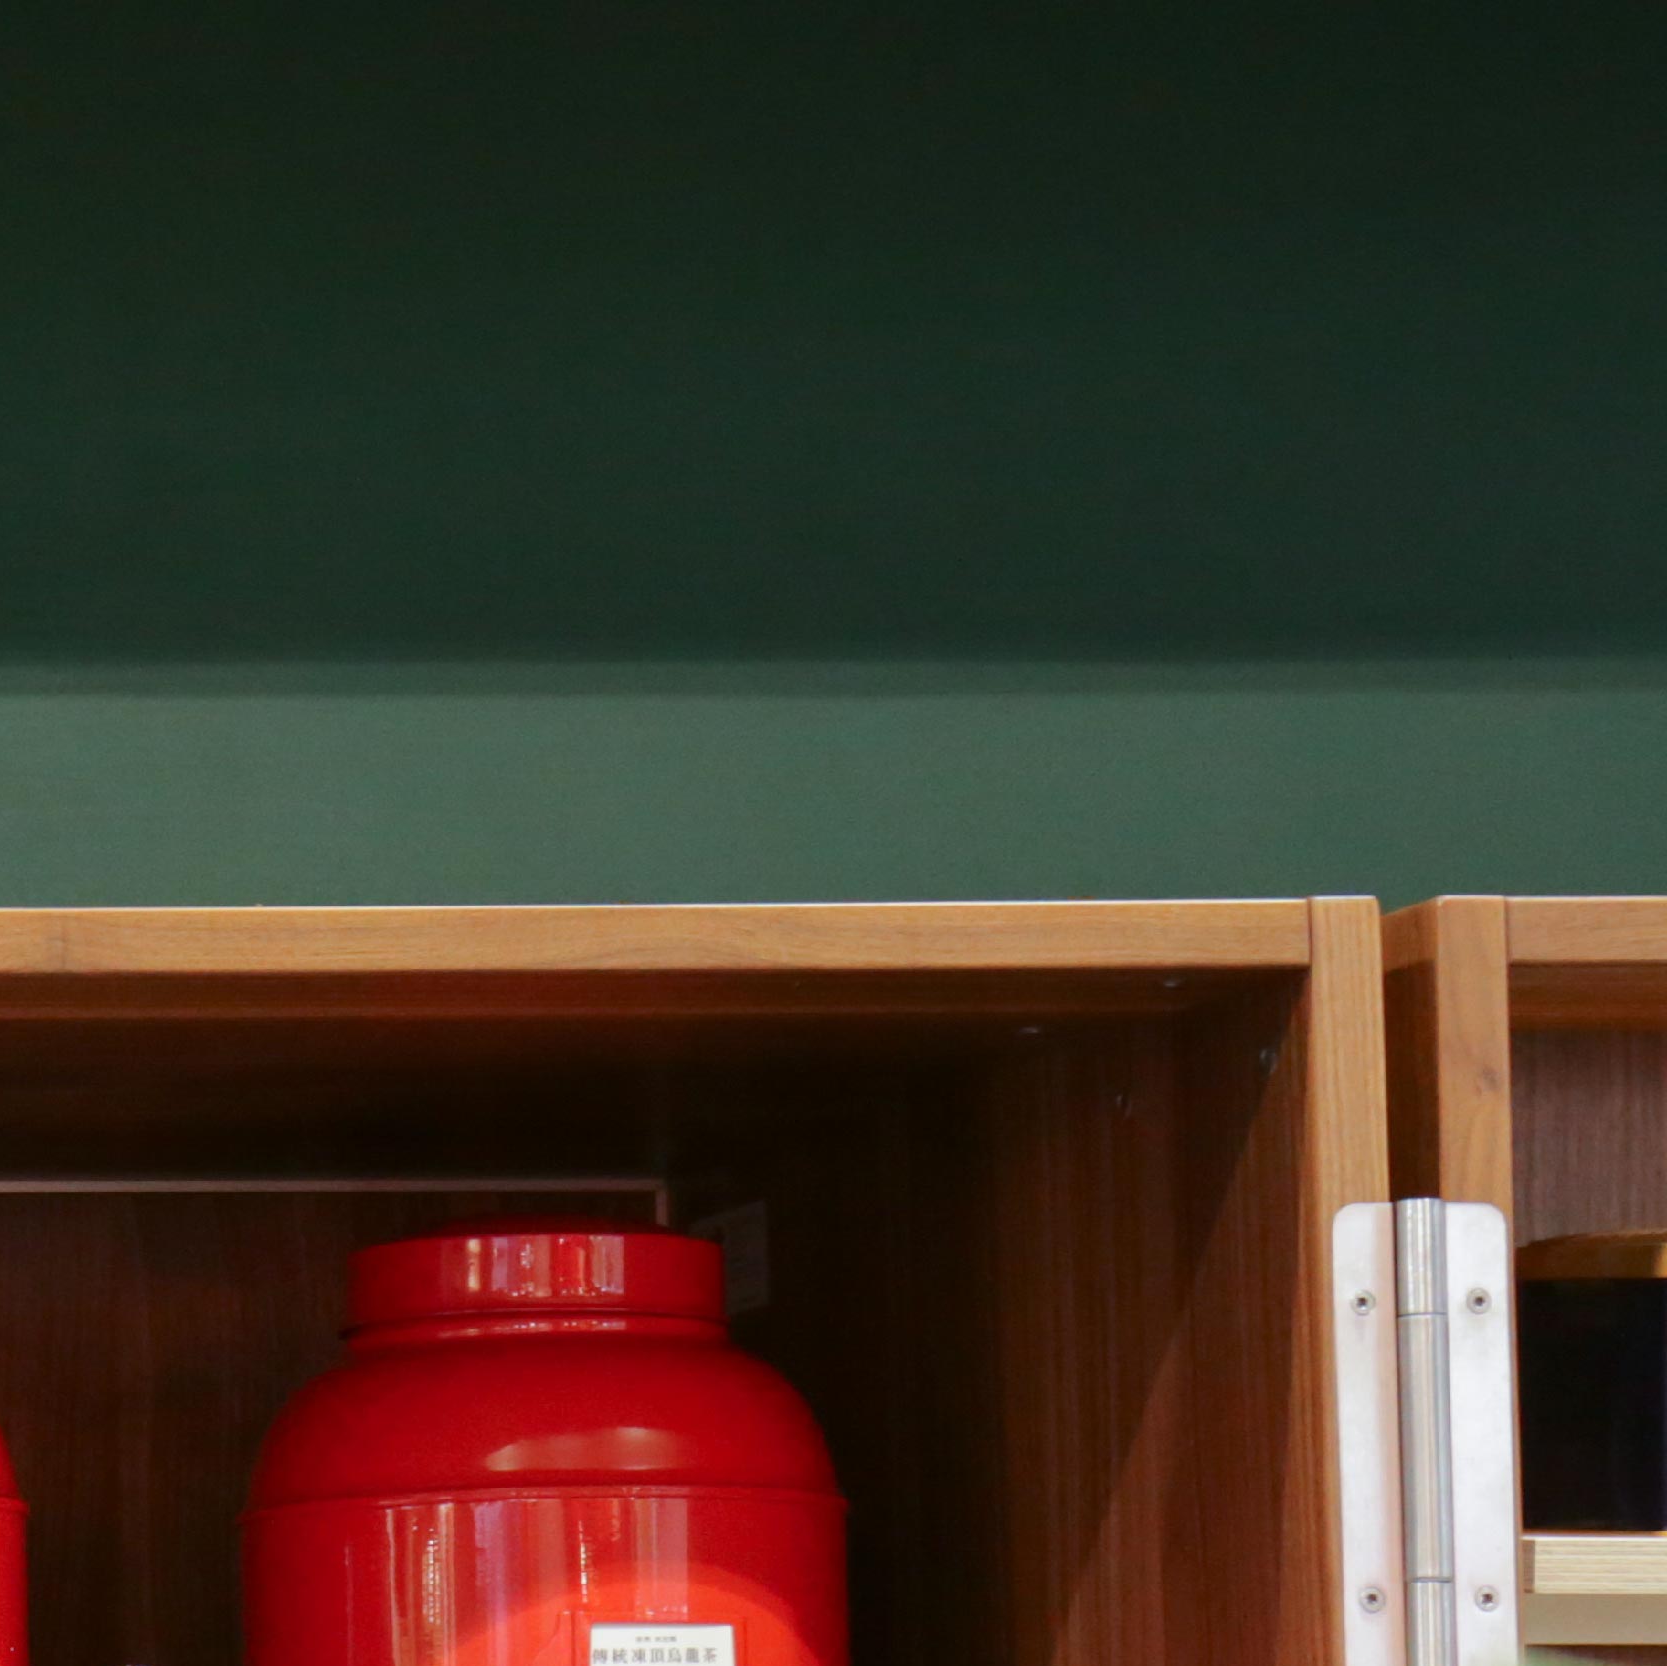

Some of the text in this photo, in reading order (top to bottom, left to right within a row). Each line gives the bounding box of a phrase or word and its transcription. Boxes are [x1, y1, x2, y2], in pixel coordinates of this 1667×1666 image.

[591, 1647, 718, 1664] 傳統凍頂烏龍茶
